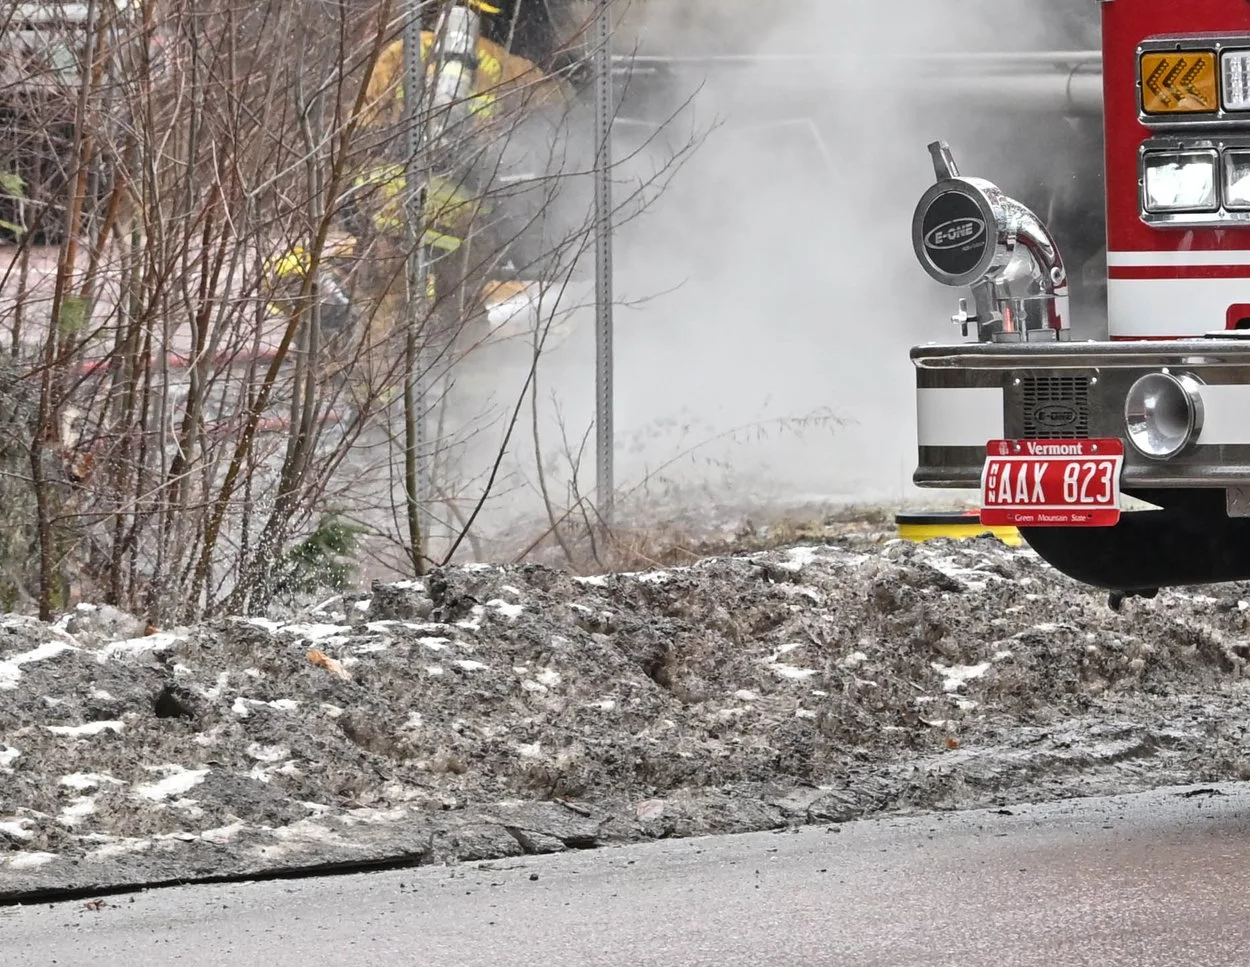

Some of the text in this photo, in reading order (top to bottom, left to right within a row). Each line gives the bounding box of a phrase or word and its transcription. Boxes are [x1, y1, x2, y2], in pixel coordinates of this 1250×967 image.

[935, 223, 974, 245] E-ONE
[1027, 441, 1083, 455] Vermont
[997, 461, 1114, 504] AAX 823
[1014, 513, 1087, 522] Green Mountain State
